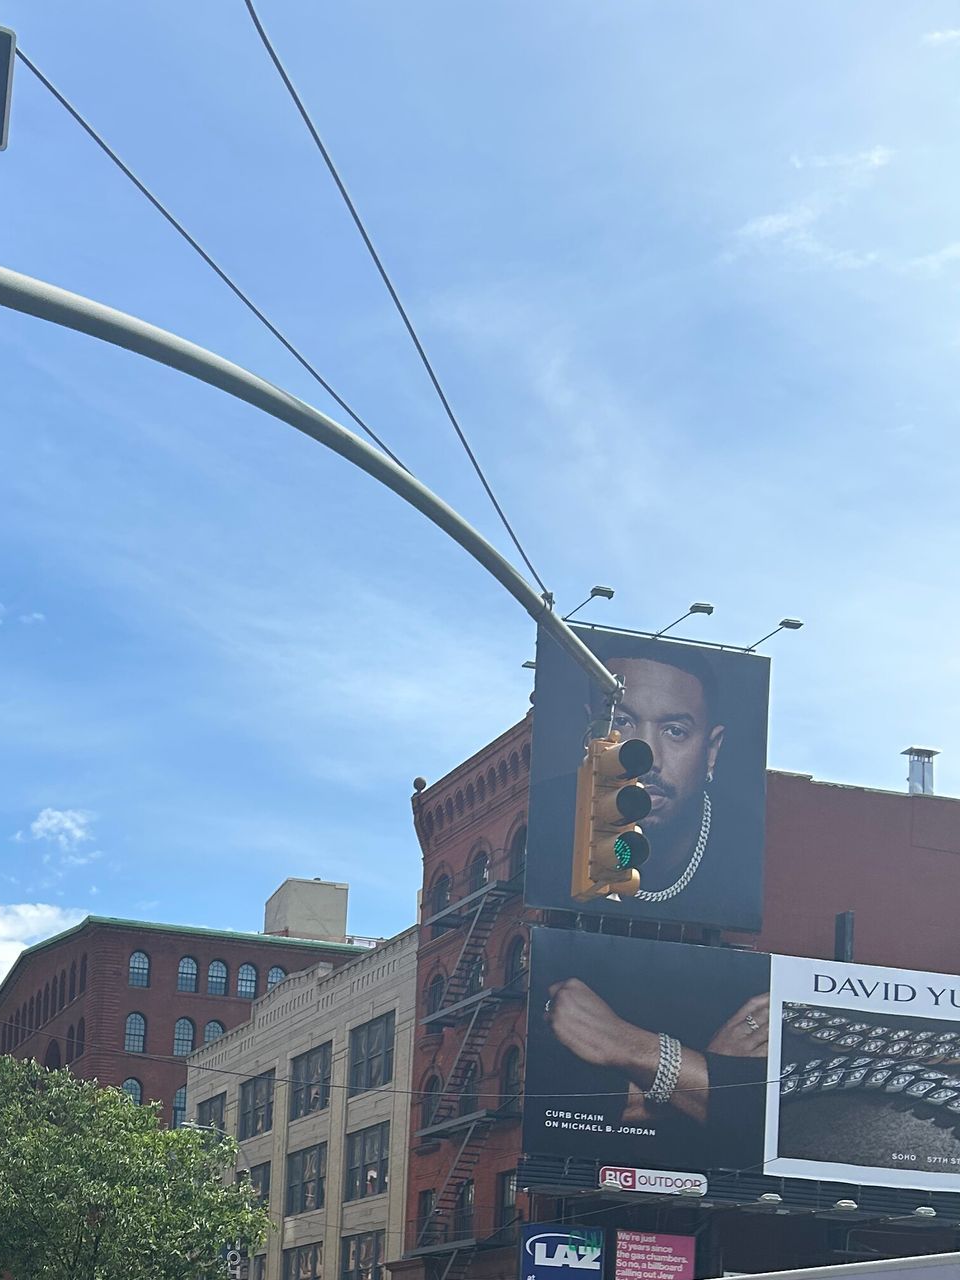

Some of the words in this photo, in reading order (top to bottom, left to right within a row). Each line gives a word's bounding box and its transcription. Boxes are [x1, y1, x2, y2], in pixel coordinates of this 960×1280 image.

[813, 973, 917, 1002] DAVID
[545, 1109, 572, 1119] CURB
[574, 1112, 604, 1122] CHAIN
[544, 1120, 559, 1128] ON
[561, 1122, 603, 1132] MICHAEL
[605, 1125, 615, 1133] B.
[617, 1126, 656, 1136] JORDAN
[891, 1153, 917, 1161] SOHO
[927, 1155, 948, 1164] 57TH
[605, 1170, 633, 1187] BIG
[617, 1231, 640, 1241] We're
[640, 1234, 656, 1243] just
[617, 1241, 627, 1249] 75
[628, 1243, 651, 1251] years
[651, 1245, 673, 1253] since
[534, 1242, 601, 1270] LAZ
[616, 1250, 630, 1259] the
[630, 1252, 645, 1260] gas
[646, 1253, 688, 1264] chambers.
[616, 1258, 627, 1267] So
[647, 1261, 683, 1272] billboard
[615, 1268, 642, 1278] calling
[657, 1272, 674, 1280] Jew
